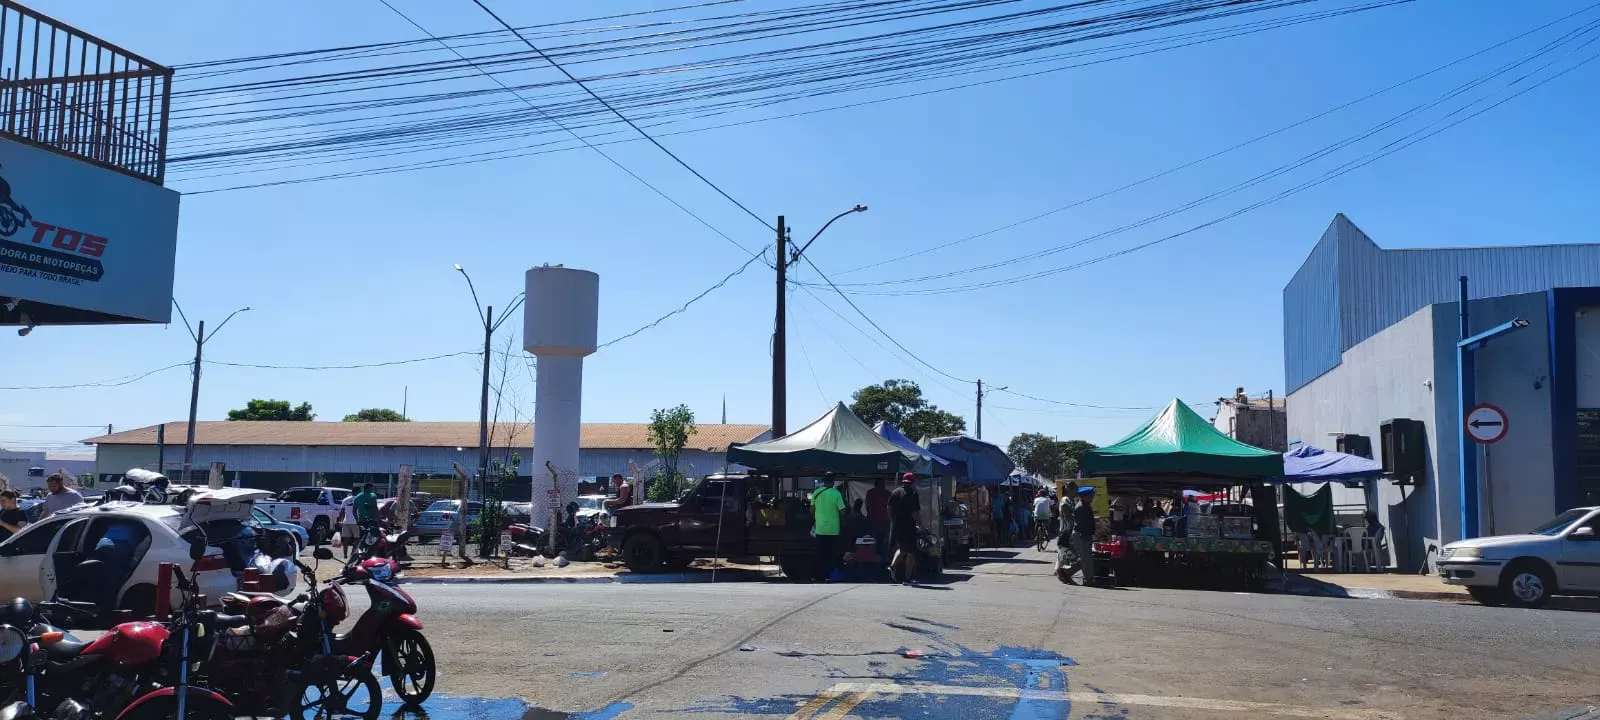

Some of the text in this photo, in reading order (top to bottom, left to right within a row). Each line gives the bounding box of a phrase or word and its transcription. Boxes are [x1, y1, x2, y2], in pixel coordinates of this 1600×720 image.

[0, 247, 98, 275] DORA DE MOTOPEÇAS
[19, 268, 37, 278] PARA
[39, 271, 57, 281] TODO
